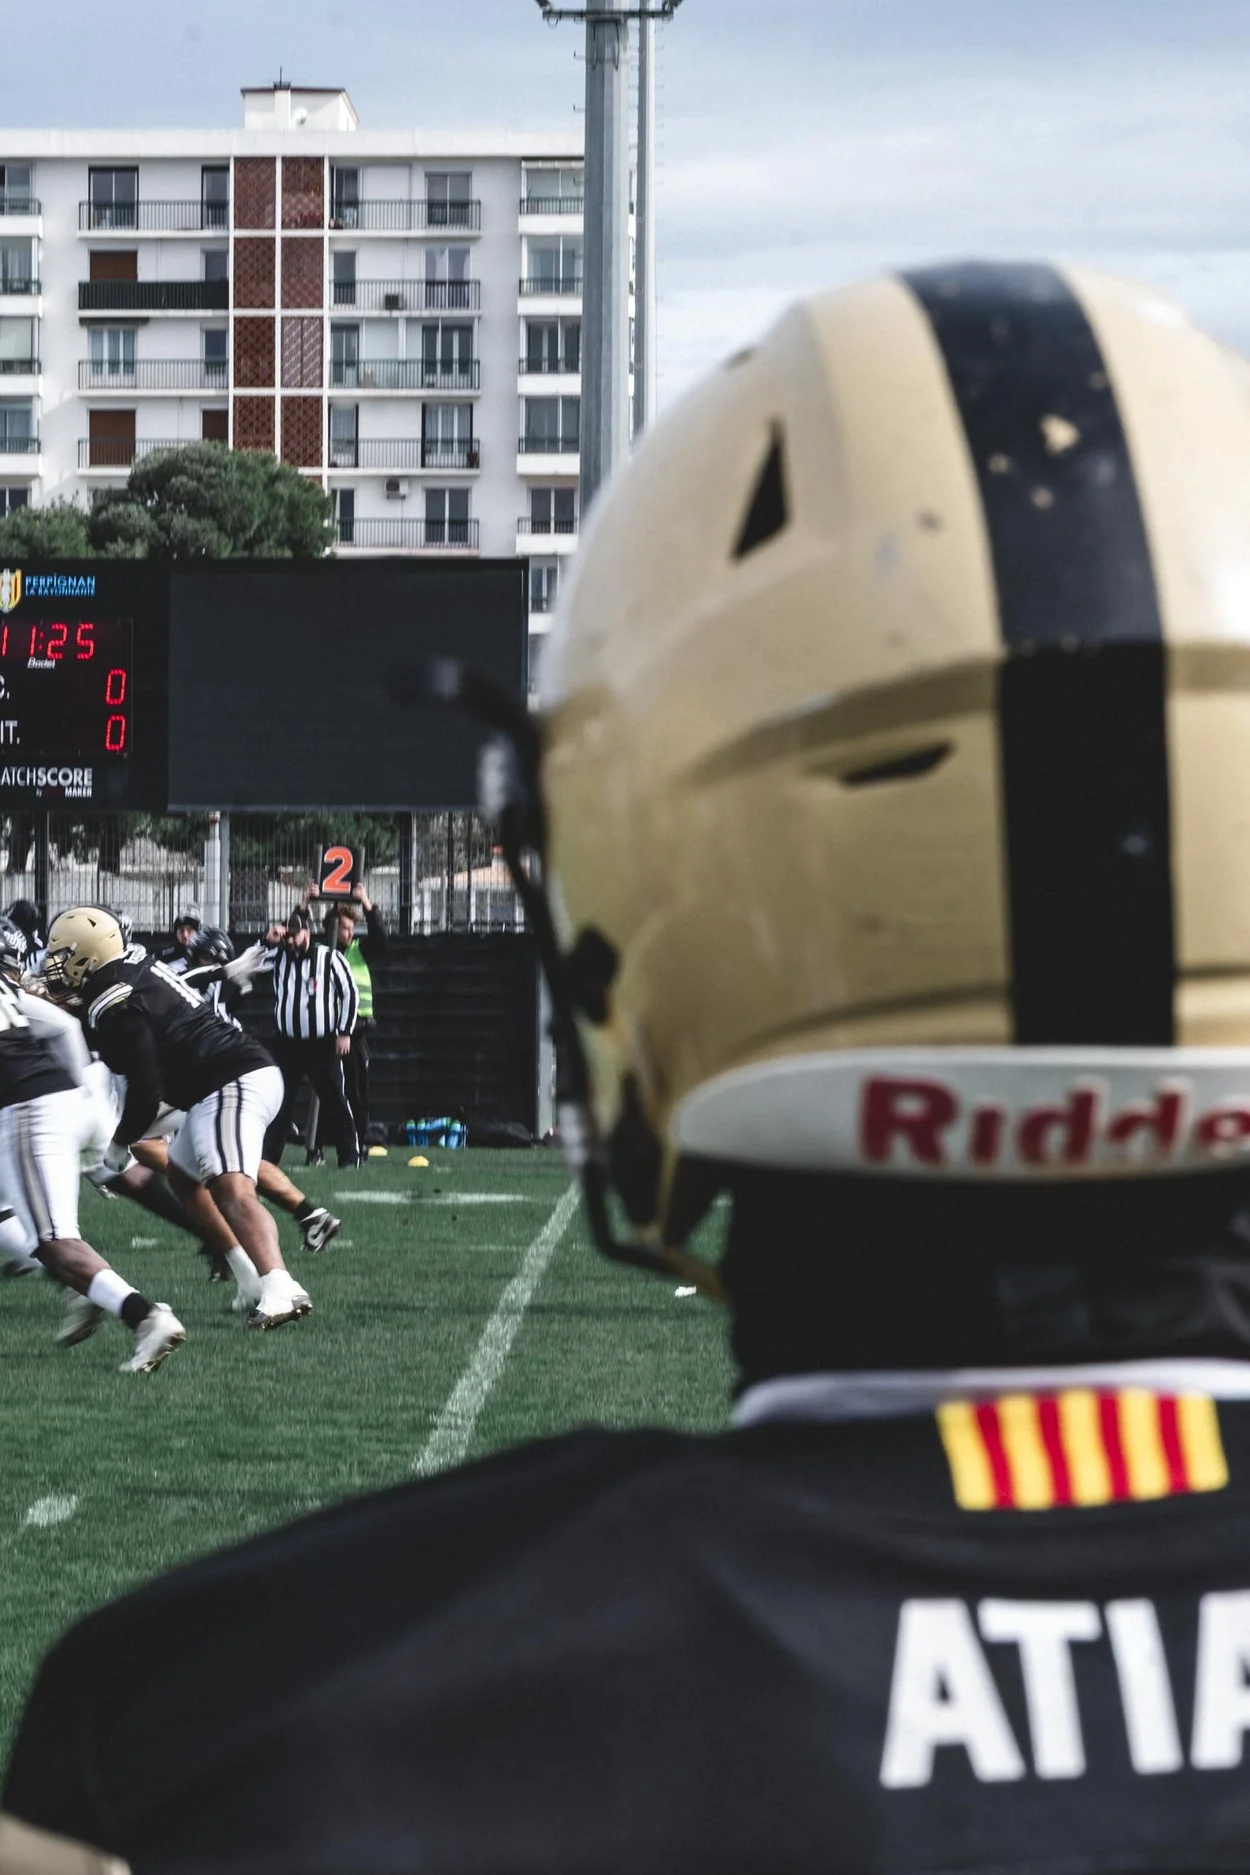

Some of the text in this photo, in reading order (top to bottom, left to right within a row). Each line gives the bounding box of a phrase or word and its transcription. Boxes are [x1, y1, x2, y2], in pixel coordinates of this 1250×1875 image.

[1, 623, 94, 659] 11:25
[105, 669, 126, 705] 0
[105, 715, 126, 751] 0
[321, 846, 354, 893] 2
